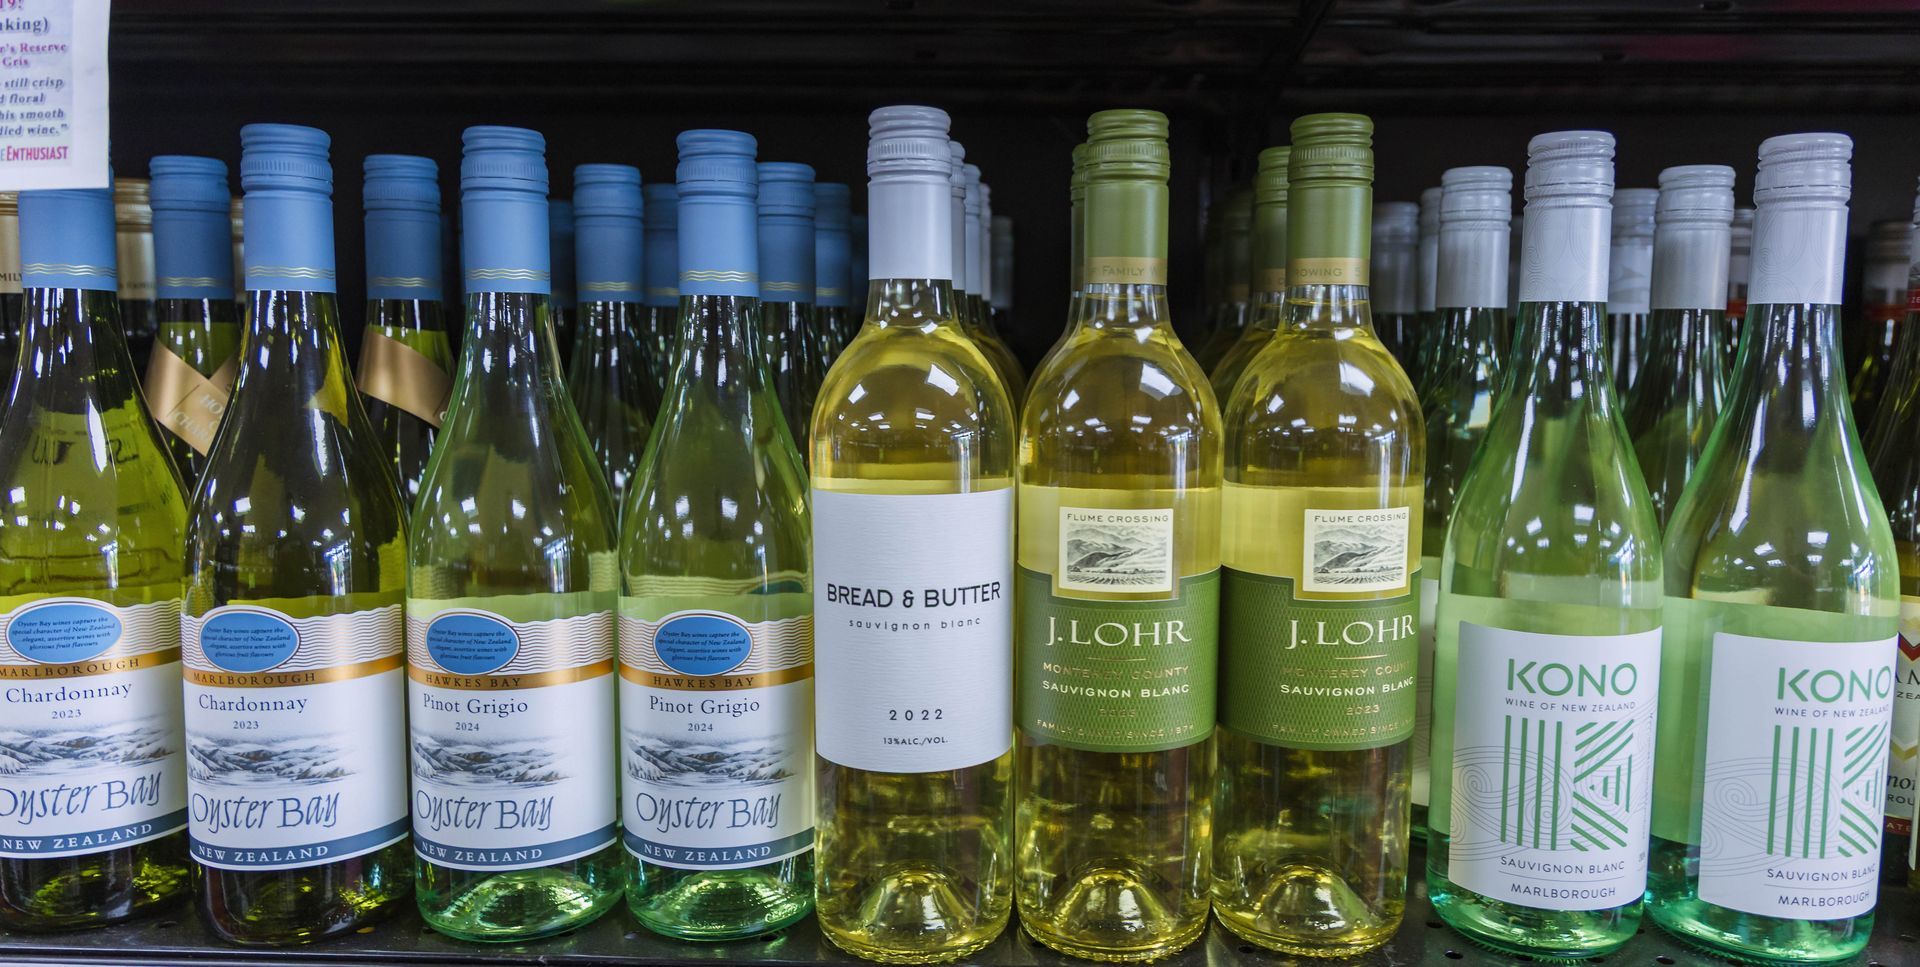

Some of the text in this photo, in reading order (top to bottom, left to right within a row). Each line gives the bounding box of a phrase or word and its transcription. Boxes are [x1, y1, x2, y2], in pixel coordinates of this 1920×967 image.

[20, 43, 67, 53] Reserve
[2, 56, 29, 67] Gris
[4, 76, 64, 91] still crisp
[9, 92, 45, 104] floral
[20, 108, 65, 120] smooth
[1067, 513, 1169, 523] FLUME CROSSING
[1314, 512, 1407, 523] FLUME CROSSING
[827, 581, 1001, 609] BREAD & BUTTER
[849, 617, 981, 632] sauvignon blanc
[1046, 616, 1192, 647] J.LOHR
[1285, 614, 1416, 650] J.LOHR
[0, 658, 140, 677] MARLBOROUGH
[193, 672, 316, 685] MARLBOROUGH
[426, 674, 521, 688] HAWKES BAY
[653, 677, 754, 689] HAWKES BAY
[1507, 658, 1637, 697] KONO
[1777, 665, 1892, 703] KONO
[6, 683, 132, 703] Chardonnay
[1042, 681, 1190, 698] SAUVIGNON BLANC
[1280, 676, 1414, 697] SAUVIGNON BLANC
[199, 694, 308, 713] Chardonnay
[424, 693, 528, 718] Pinot Grigio
[650, 695, 760, 718] Pinot Grigio
[1505, 697, 1636, 712] WINE OF NEW ZEALAND
[1774, 704, 1889, 718] WINE OF NEW ZEALAND
[51, 709, 82, 720] 2023
[889, 709, 943, 721] 2022
[233, 721, 259, 730] 2023
[455, 721, 480, 731] 2024
[687, 722, 714, 732] 2024
[0, 771, 162, 825] Oyster Bay
[192, 791, 341, 834] Oyster Bay
[416, 790, 554, 831] Oyster Bay
[636, 792, 781, 834] Oyster Bay
[3, 823, 152, 850] NEW ZEALAND
[199, 845, 328, 862] NEW ZEALAND
[422, 841, 542, 862] NEW ZEALAND
[644, 843, 771, 861] NEW ZEALAND
[1501, 856, 1625, 874] SAUVIGNON BLANC
[1767, 863, 1876, 882] SAUVIGNON BLANC
[1510, 883, 1616, 899] MARLBOROUGH
[1778, 890, 1870, 907] MARLBOROUGH
